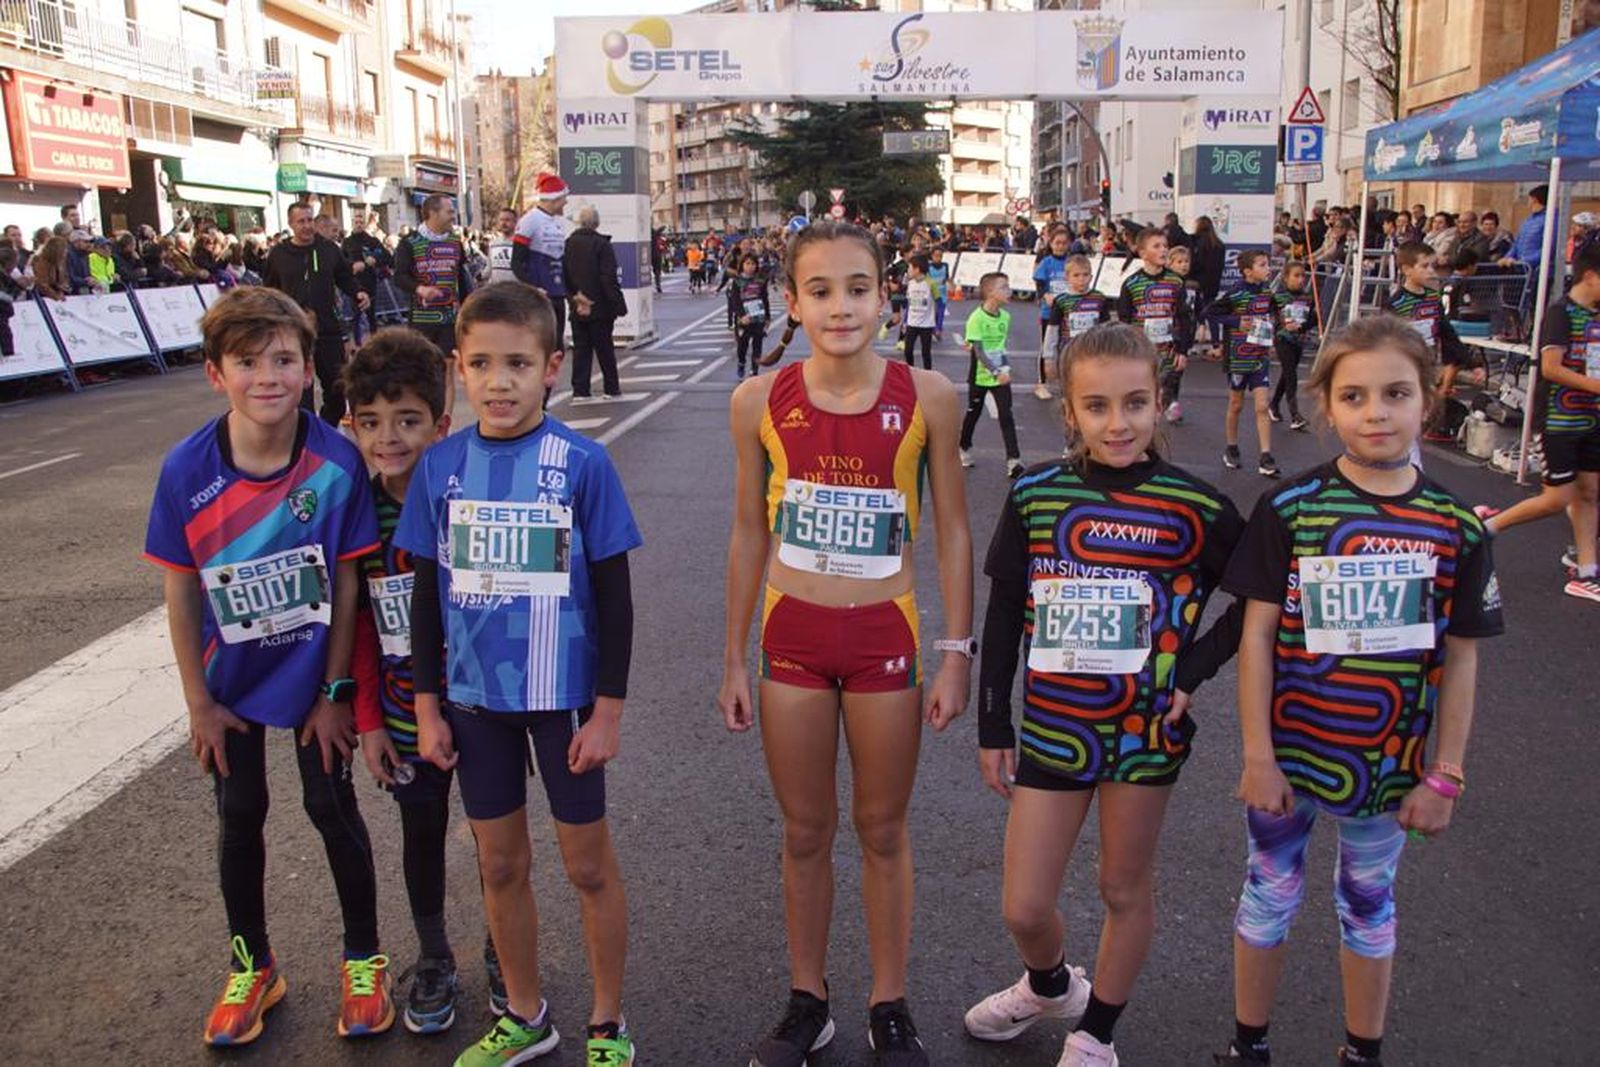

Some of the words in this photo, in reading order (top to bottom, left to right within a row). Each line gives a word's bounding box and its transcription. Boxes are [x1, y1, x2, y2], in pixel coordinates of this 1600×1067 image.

[629, 49, 742, 71] SETEL
[1125, 45, 1246, 65] Ayuntamiento
[699, 71, 742, 82] Grupo
[1125, 66, 1146, 82] de
[1153, 66, 1246, 82] Salamanca
[858, 83, 970, 93] SALMANTINA
[51, 105, 123, 137] TABACOS
[1293, 128, 1317, 159] P
[574, 149, 622, 176] JRG
[1211, 147, 1261, 175] JRG
[818, 454, 864, 472] VINO
[803, 471, 826, 485] DE
[828, 472, 879, 487] TORO
[814, 489, 894, 509] SETEL
[476, 507, 559, 524] SETEL
[796, 504, 876, 548] 5966
[1088, 520, 1158, 545] XXXVIII
[468, 526, 529, 565] 6011
[1338, 558, 1424, 578] SETEL
[225, 569, 302, 616] 6007
[1060, 584, 1140, 601] SETEL
[1319, 580, 1407, 621] 6047
[1046, 604, 1121, 642] 6253
[259, 629, 314, 648] Adarsa
